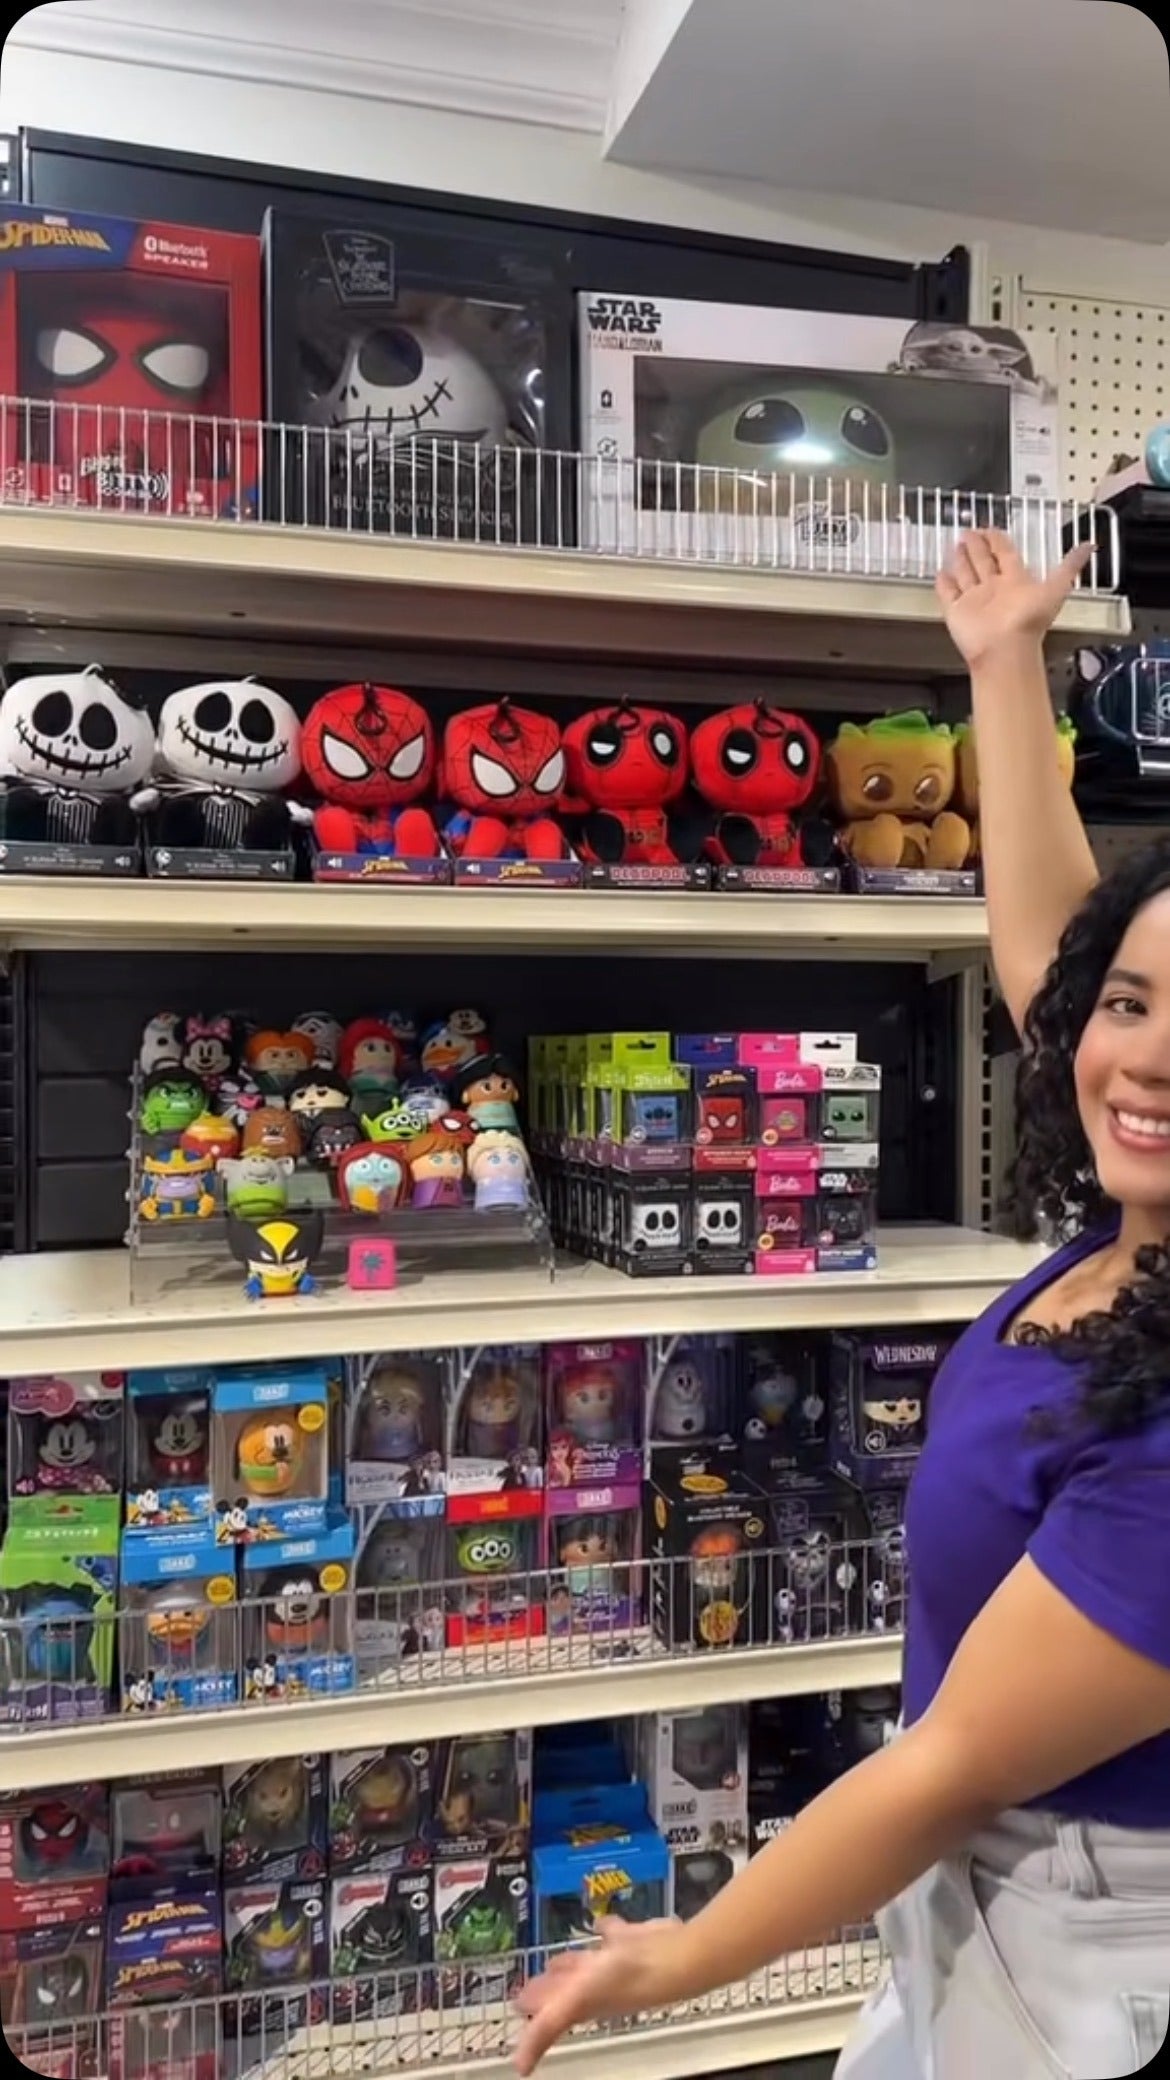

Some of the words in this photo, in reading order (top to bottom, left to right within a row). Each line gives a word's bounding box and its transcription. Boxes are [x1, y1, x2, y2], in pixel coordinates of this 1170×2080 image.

[157, 238, 208, 257] Bluetooth
[144, 252, 208, 269] SPEAKER
[587, 298, 662, 317] STAR
[588, 314, 661, 333] WARS
[766, 1214, 799, 1233] Barbie
[120, 1904, 208, 1933] SPIDER-MAN
